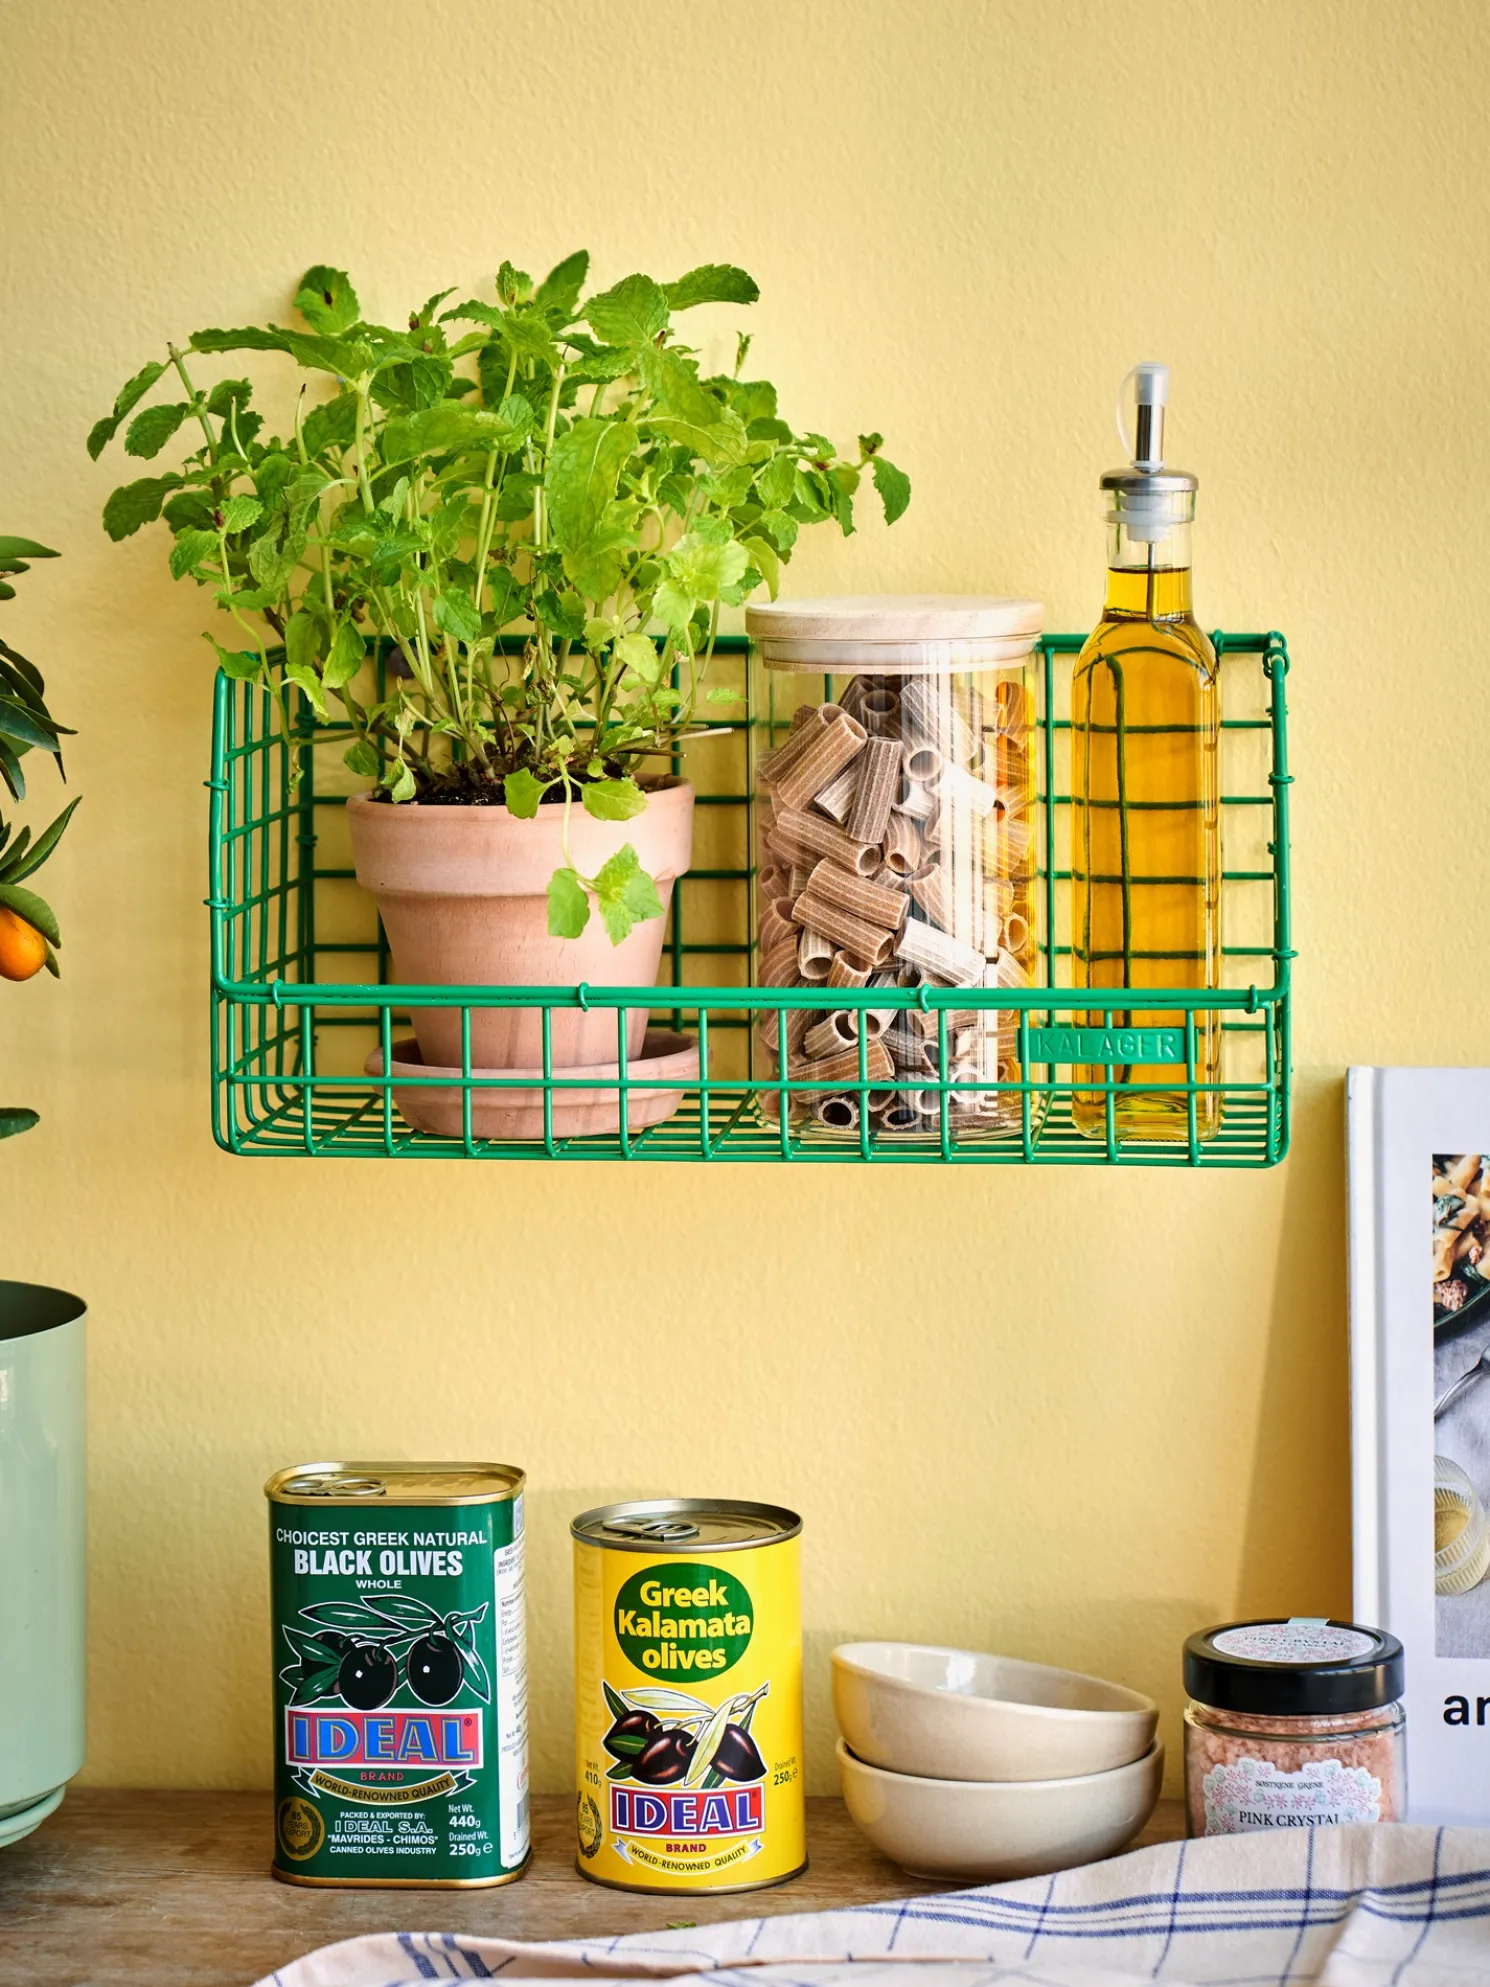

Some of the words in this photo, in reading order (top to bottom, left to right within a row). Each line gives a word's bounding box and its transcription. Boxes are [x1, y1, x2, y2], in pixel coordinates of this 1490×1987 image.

[1037, 1033, 1175, 1058] KALAGER
[276, 1528, 349, 1546] CHOICEST
[353, 1532, 409, 1547] GREEK
[413, 1530, 487, 1546] NATURAL
[294, 1549, 373, 1576] BLACK
[379, 1550, 463, 1576] OLIVES
[355, 1579, 402, 1589] WHOLE
[640, 1579, 729, 1608] Greek
[618, 1609, 751, 1638] Kalamata
[642, 1642, 727, 1669] olives
[292, 1716, 475, 1762] IDEAL
[360, 1772, 404, 1781] BRAND
[585, 1770, 602, 1788] 410g
[315, 1774, 409, 1801] WORLD-RENOWNED
[412, 1778, 450, 1797] QUALITY
[340, 1811, 368, 1819] PACKED
[376, 1812, 413, 1820] EXPORTED
[448, 1804, 461, 1813] Net
[461, 1804, 474, 1813] Wt.
[616, 1792, 759, 1833] IDEAL
[335, 1820, 394, 1833] IDEAL
[398, 1820, 434, 1834] S.A.
[449, 1815, 481, 1828] 440g
[1238, 1810, 1274, 1827] PINK
[449, 1832, 476, 1841] Drained
[477, 1831, 489, 1840] Wt.
[330, 1846, 364, 1854] CANNED
[365, 1846, 395, 1854] OLIVES
[396, 1847, 437, 1855] INDUSTRY
[449, 1843, 481, 1856] 250g
[666, 1843, 707, 1853] BRAND
[715, 1846, 746, 1866] QUALITY
